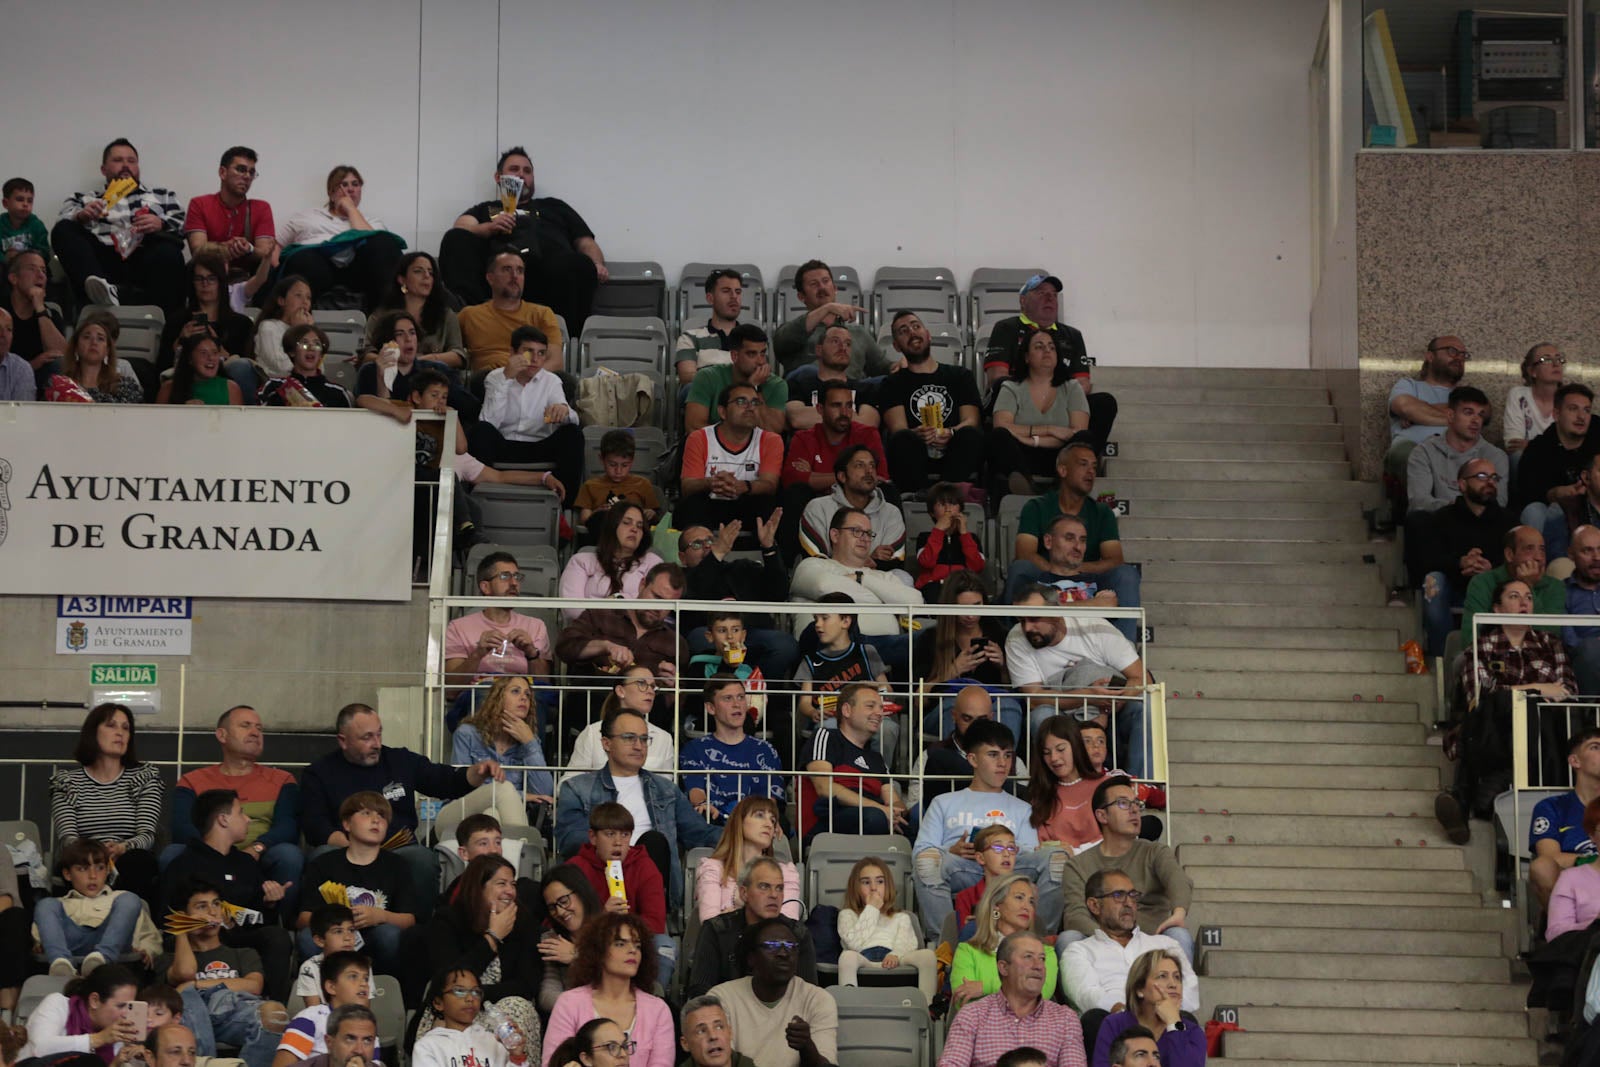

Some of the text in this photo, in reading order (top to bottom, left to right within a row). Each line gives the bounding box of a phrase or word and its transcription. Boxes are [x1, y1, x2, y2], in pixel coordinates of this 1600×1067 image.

[1106, 444, 1115, 456] 6
[26, 463, 351, 505] AYUNTAMIENTO
[1117, 501, 1127, 513] 5
[51, 512, 322, 552] DE GRANADA
[67, 597, 183, 614] A3 IMPAR
[95, 626, 183, 637] AYUNTAMIENTO
[94, 637, 167, 648] DE GRANADA
[95, 667, 152, 682] SALIDA
[1204, 930, 1219, 944] 11
[1220, 1009, 1236, 1024] 10
